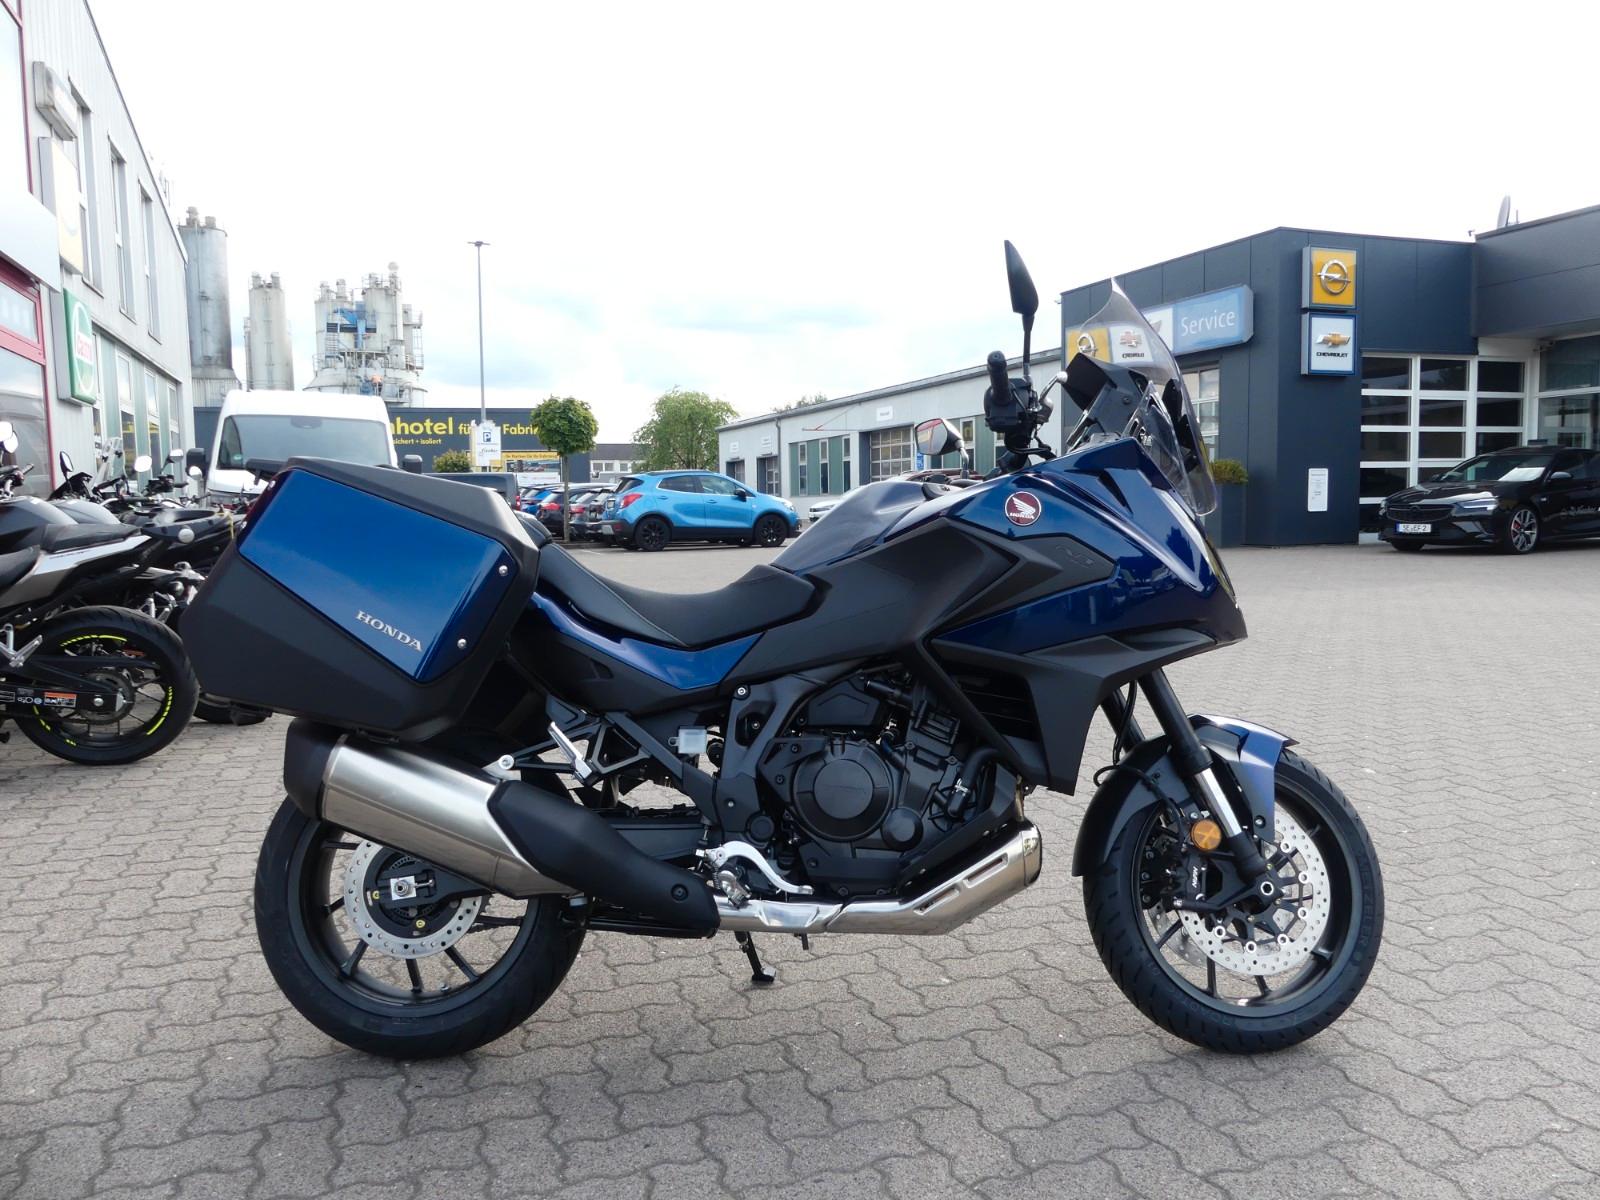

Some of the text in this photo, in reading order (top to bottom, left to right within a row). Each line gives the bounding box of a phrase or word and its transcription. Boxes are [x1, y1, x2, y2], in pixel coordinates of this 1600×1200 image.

[1181, 309, 1236, 337] Service
[457, 423, 471, 435] fü
[1009, 512, 1035, 520] HONDA
[355, 609, 423, 652] HONDA
